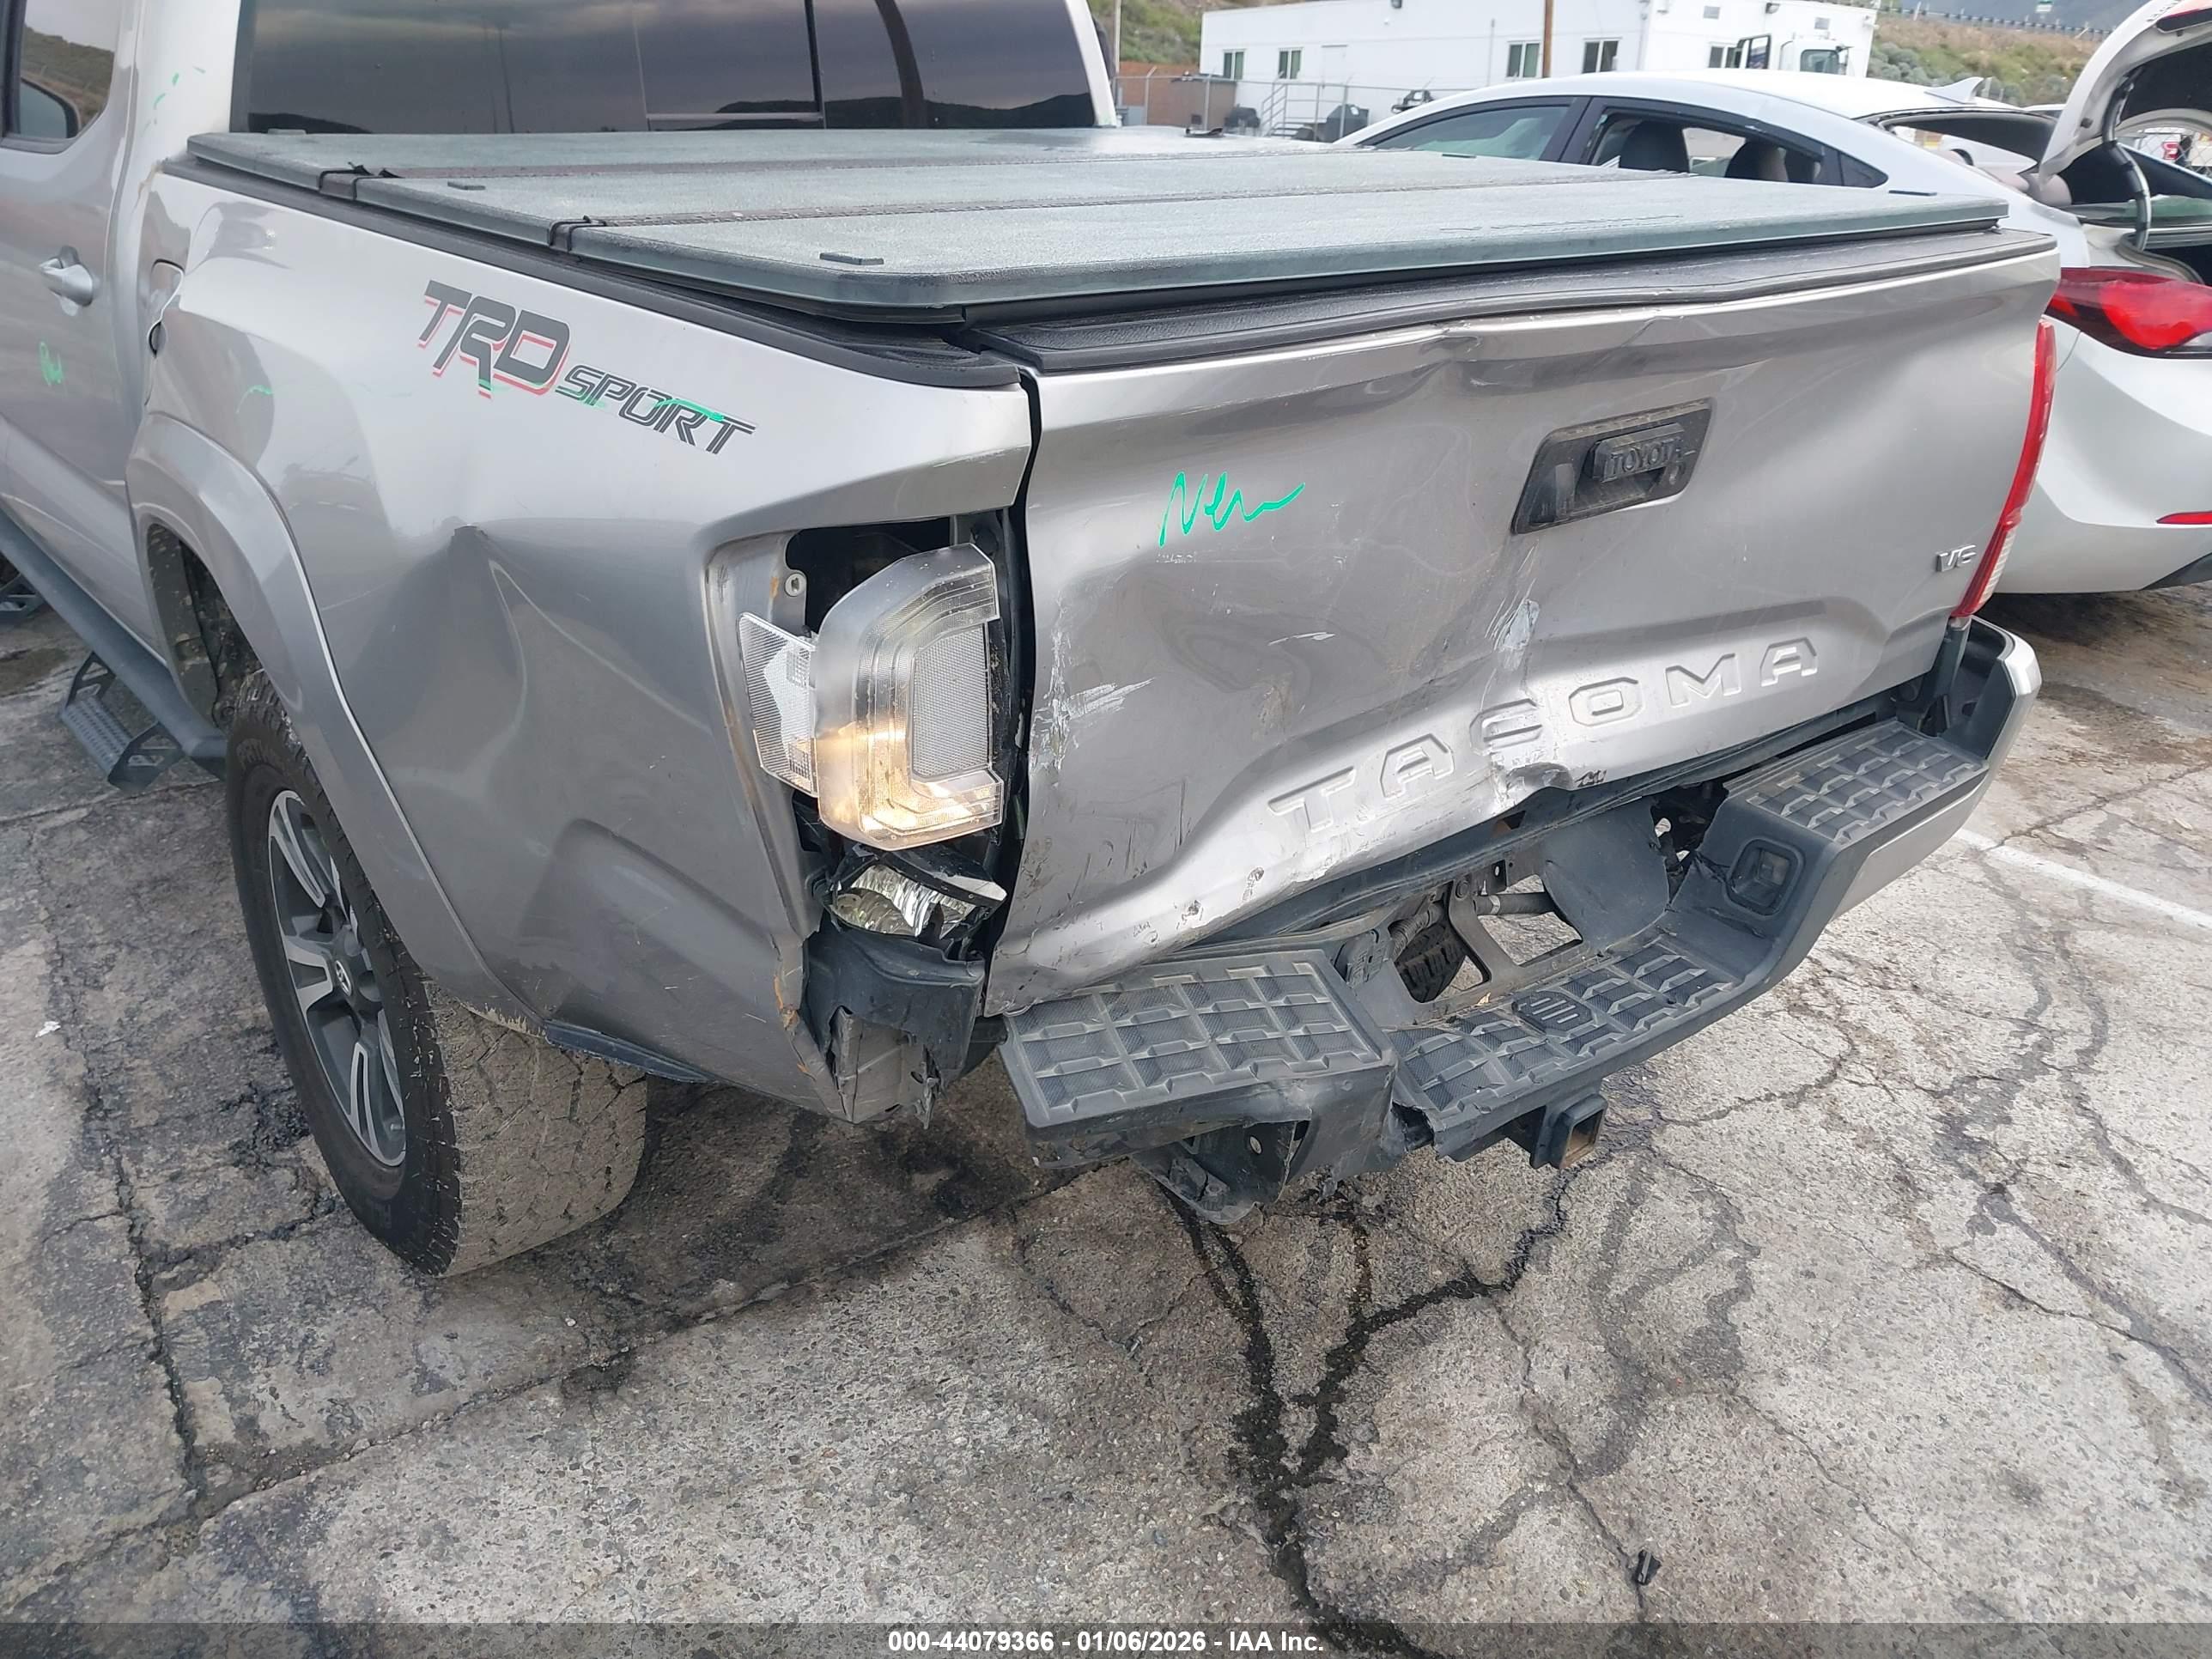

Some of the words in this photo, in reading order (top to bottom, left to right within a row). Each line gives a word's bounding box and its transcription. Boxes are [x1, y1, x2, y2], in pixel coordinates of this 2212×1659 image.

[418, 280, 570, 398] TRD
[556, 364, 756, 454] SPORT
[1936, 544, 1976, 572] V6
[1267, 636, 1819, 833] TACOMA
